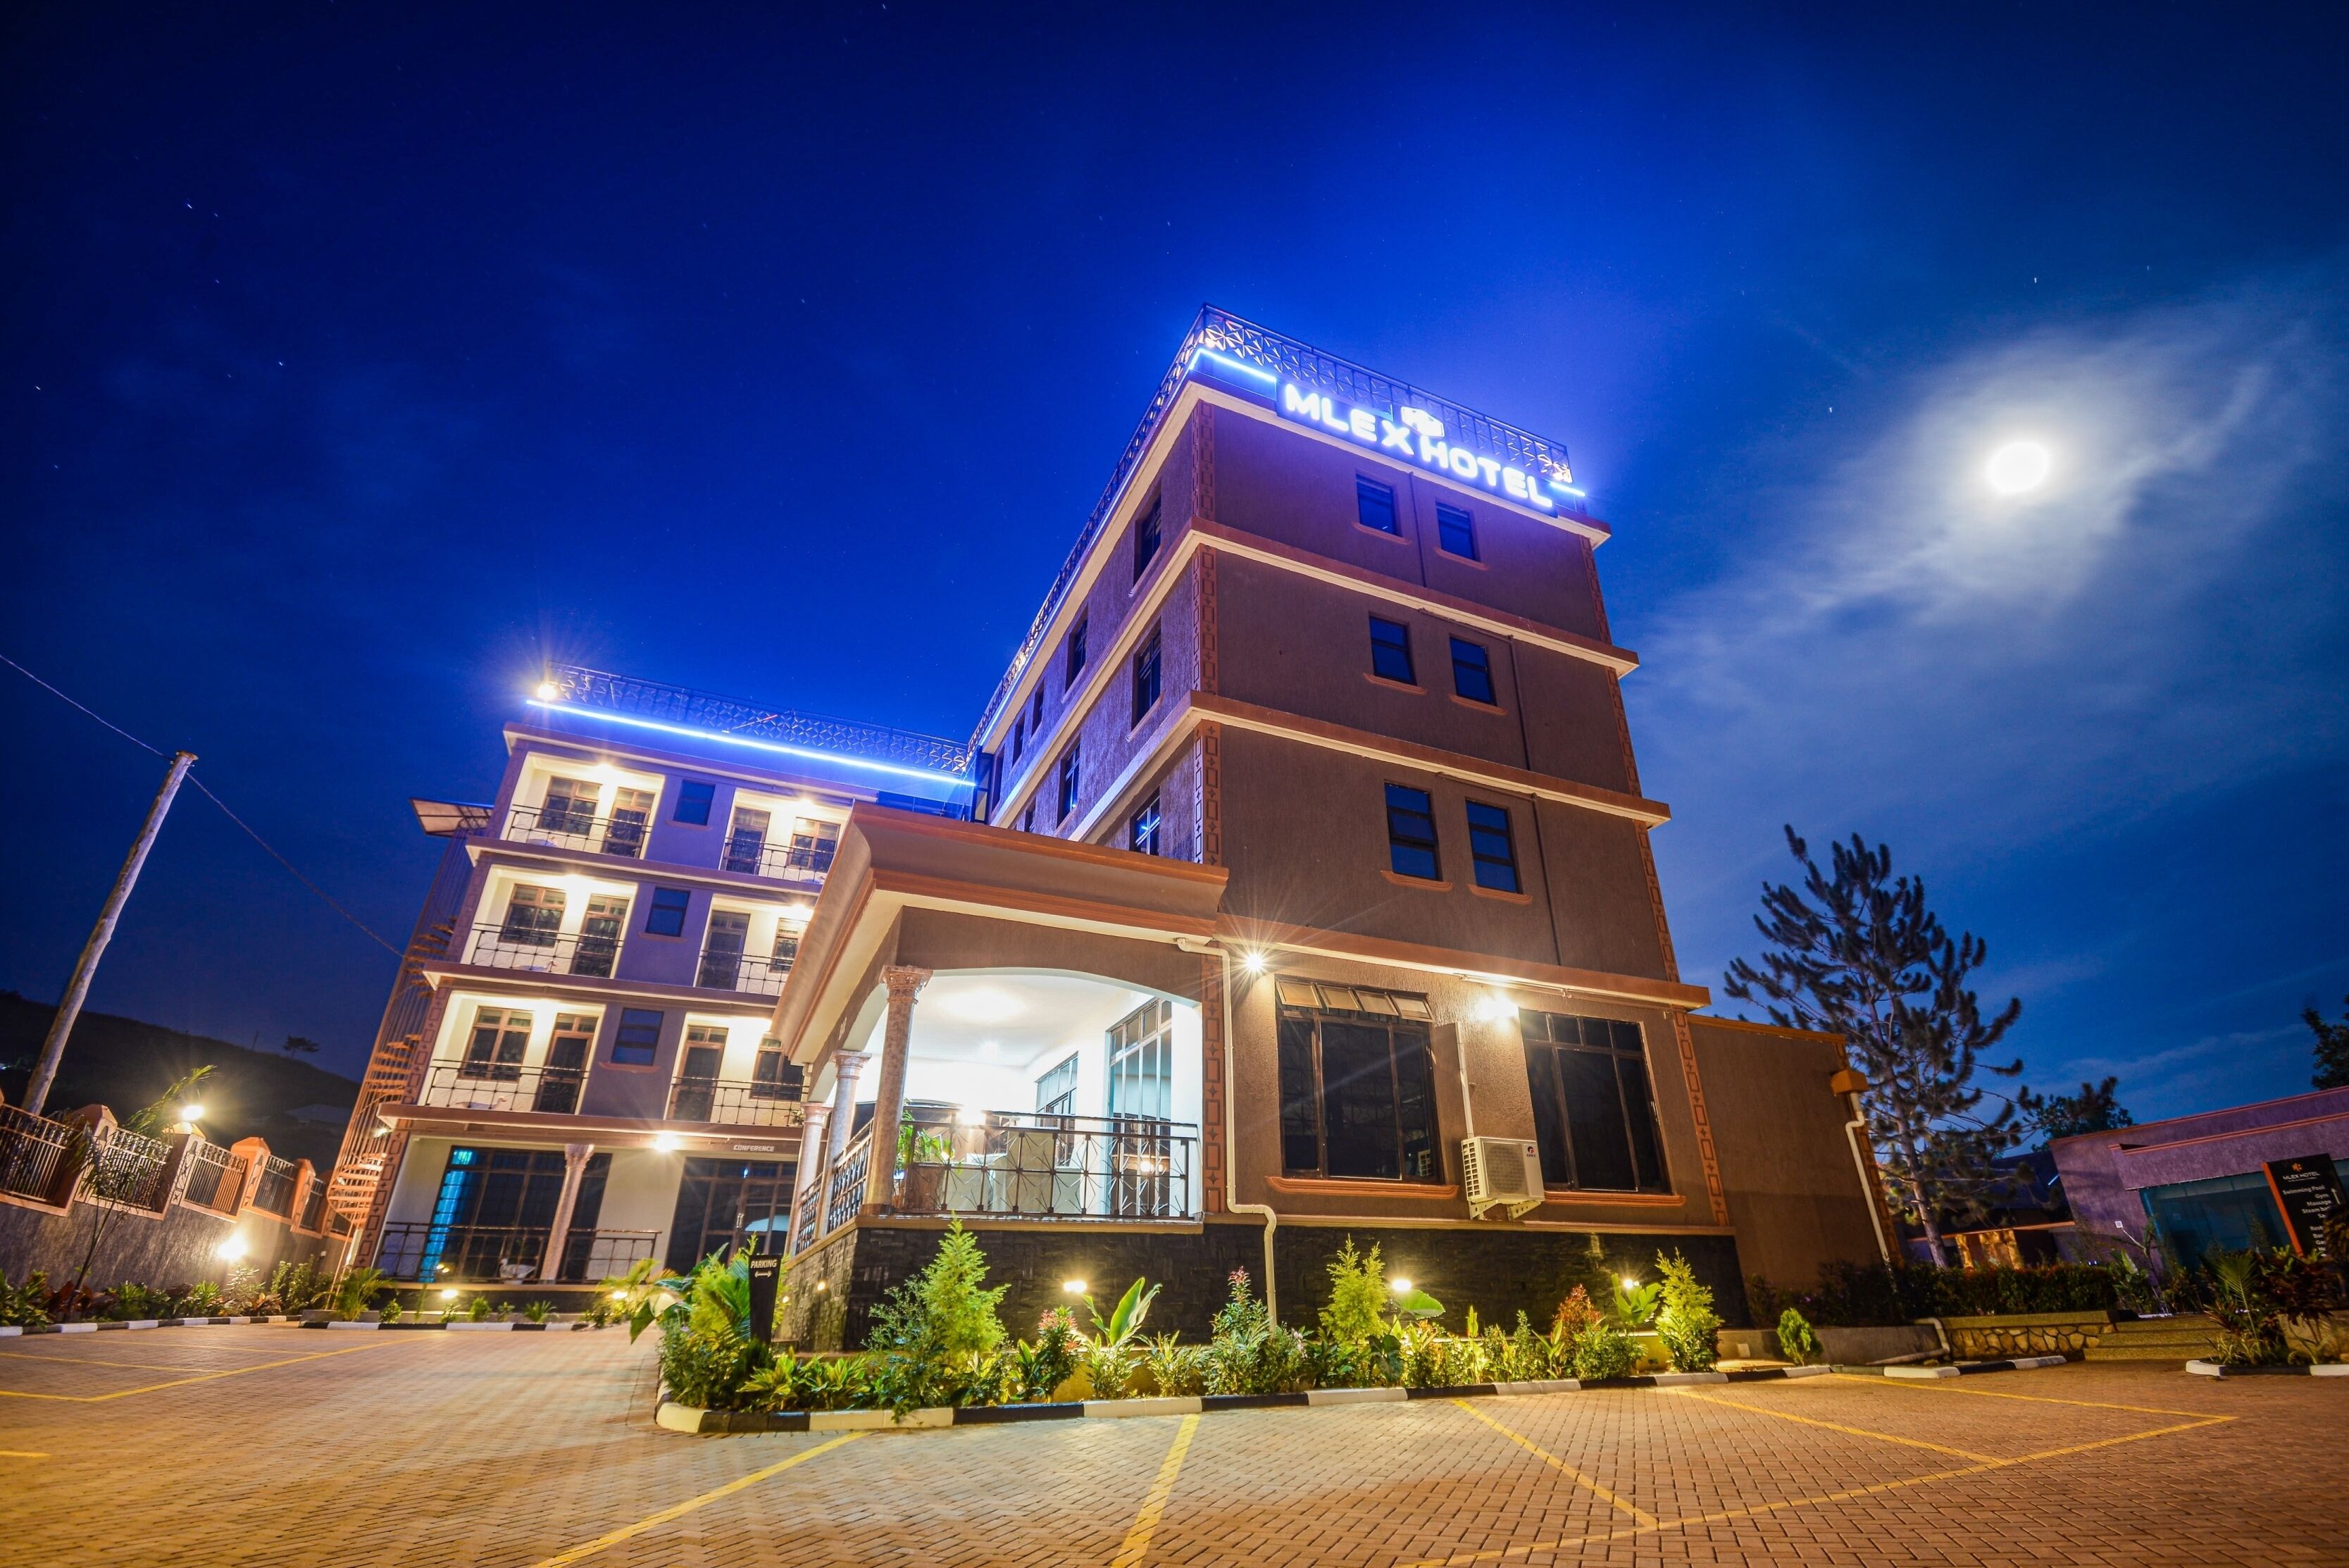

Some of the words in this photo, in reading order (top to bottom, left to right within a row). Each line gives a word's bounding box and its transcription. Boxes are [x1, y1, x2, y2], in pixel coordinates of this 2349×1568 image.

[1285, 383, 1414, 456] MLEX
[1420, 435, 1554, 508] HOTEL
[750, 1259, 778, 1269] PARKING
